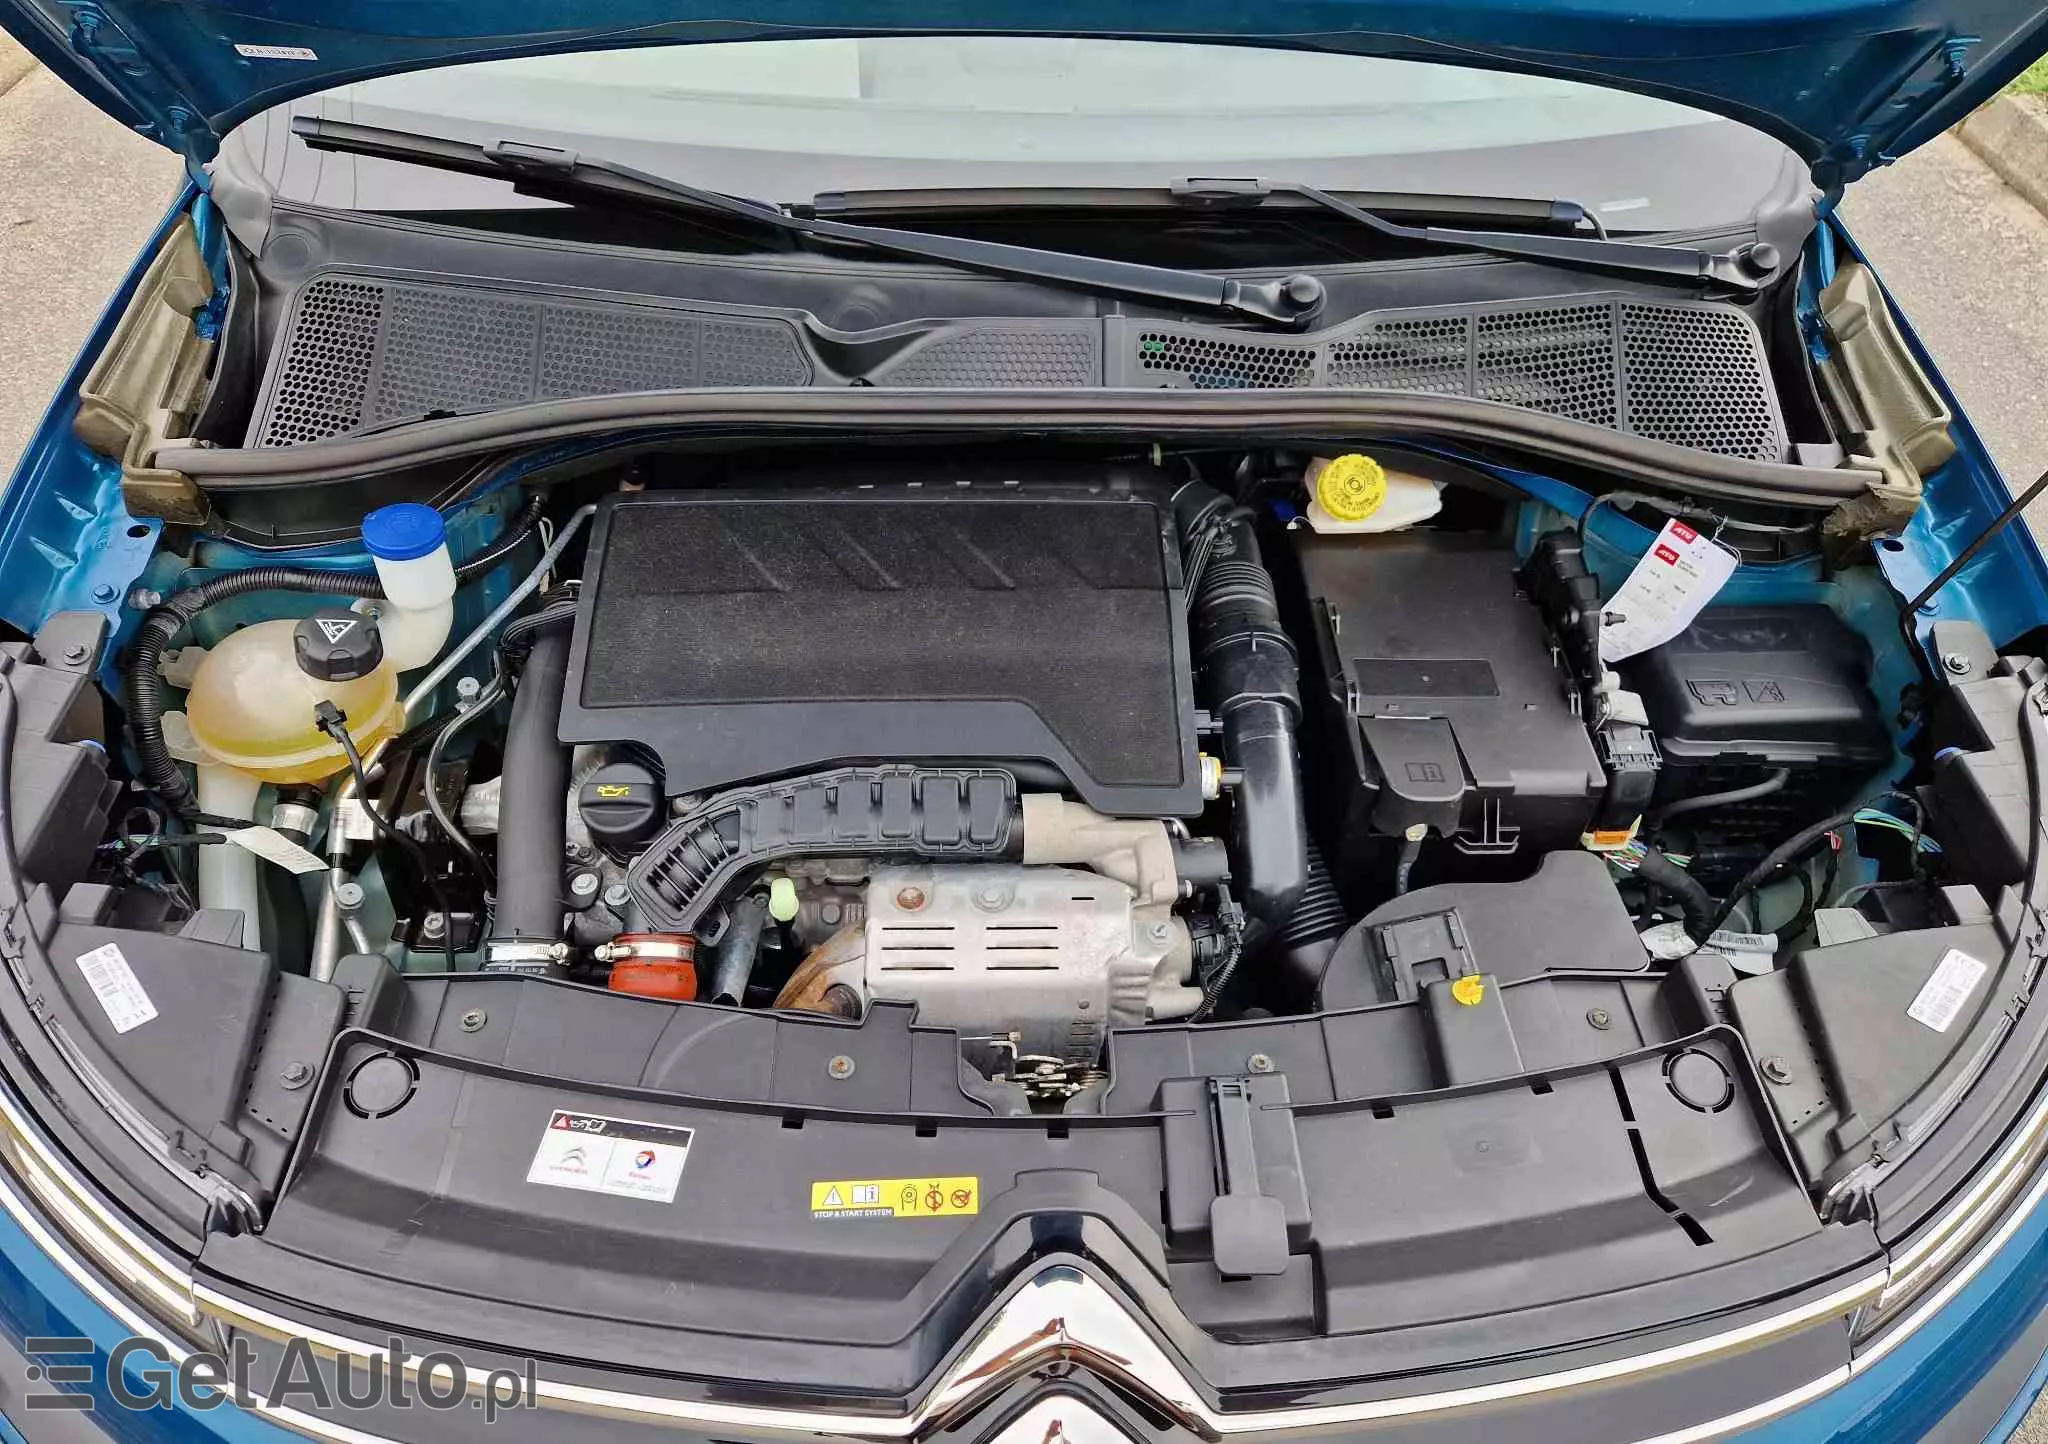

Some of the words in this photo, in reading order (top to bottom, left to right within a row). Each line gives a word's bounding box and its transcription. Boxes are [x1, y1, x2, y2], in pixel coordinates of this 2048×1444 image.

[814, 1209, 834, 1219] STOP
[840, 1209, 863, 1217] START
[864, 1208, 892, 1216] SYSTEM
